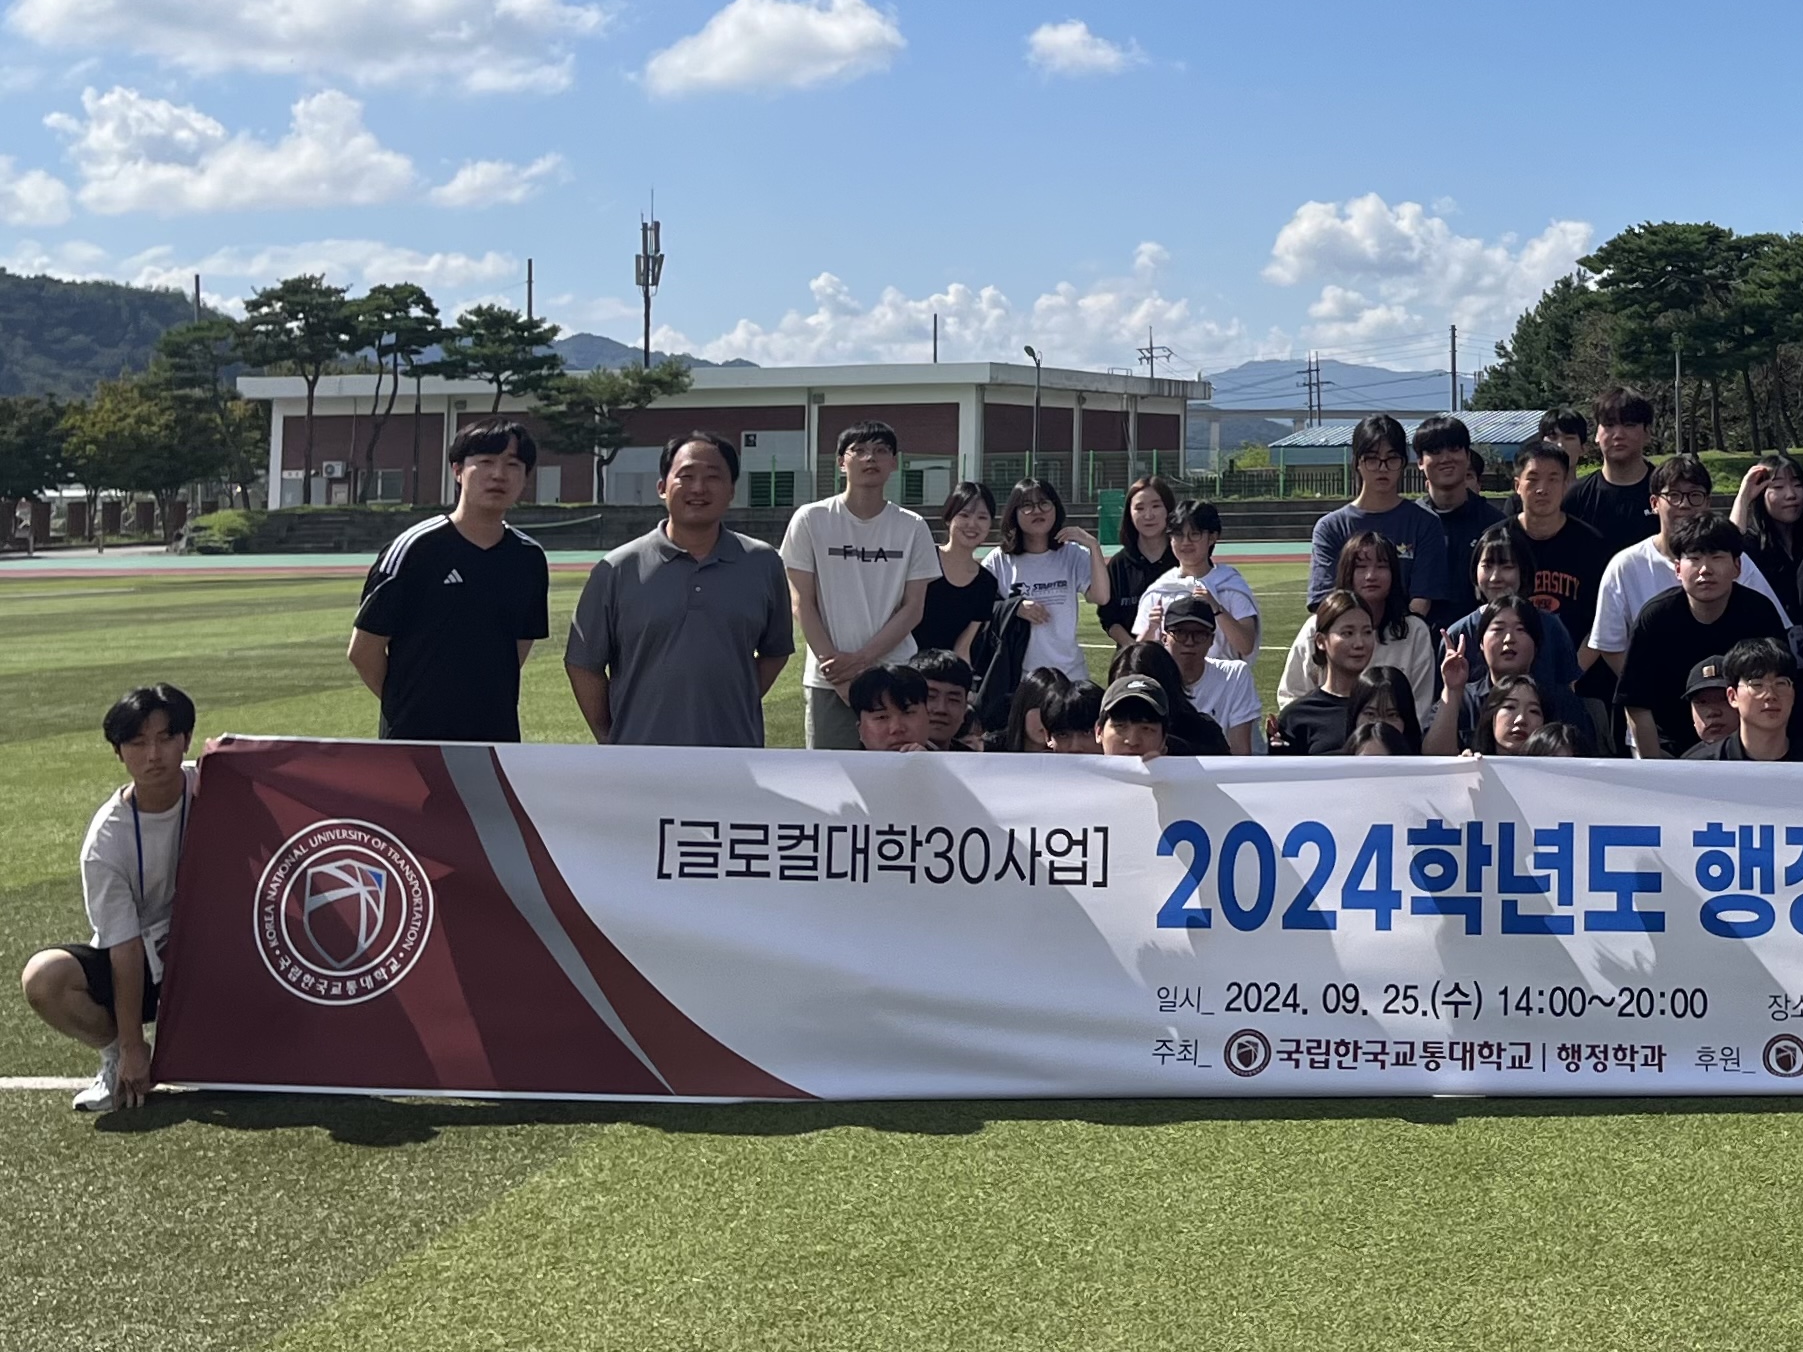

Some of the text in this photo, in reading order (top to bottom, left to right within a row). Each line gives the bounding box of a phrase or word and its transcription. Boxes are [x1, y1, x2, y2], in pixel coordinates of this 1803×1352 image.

[843, 545, 888, 563] FILA
[1534, 570, 1579, 600] ERSITY
[656, 817, 1109, 888] [글로컬대학30사업]
[263, 829, 424, 951] KOREA NATIONAL UNIVERSITY OF TRANSPORTATION
[1156, 818, 1666, 936] 2024학년도
[278, 954, 402, 996] 국립한국교통대학교
[1224, 981, 1308, 1015] 2024.
[1321, 983, 1368, 1016] 09.
[1382, 980, 1482, 1021] 25.(수)
[1498, 985, 1708, 1019] 14:00~20:00
[1275, 1038, 1534, 1072] 국립한국교통대학교
[1556, 1043, 1667, 1073] 행정학과
